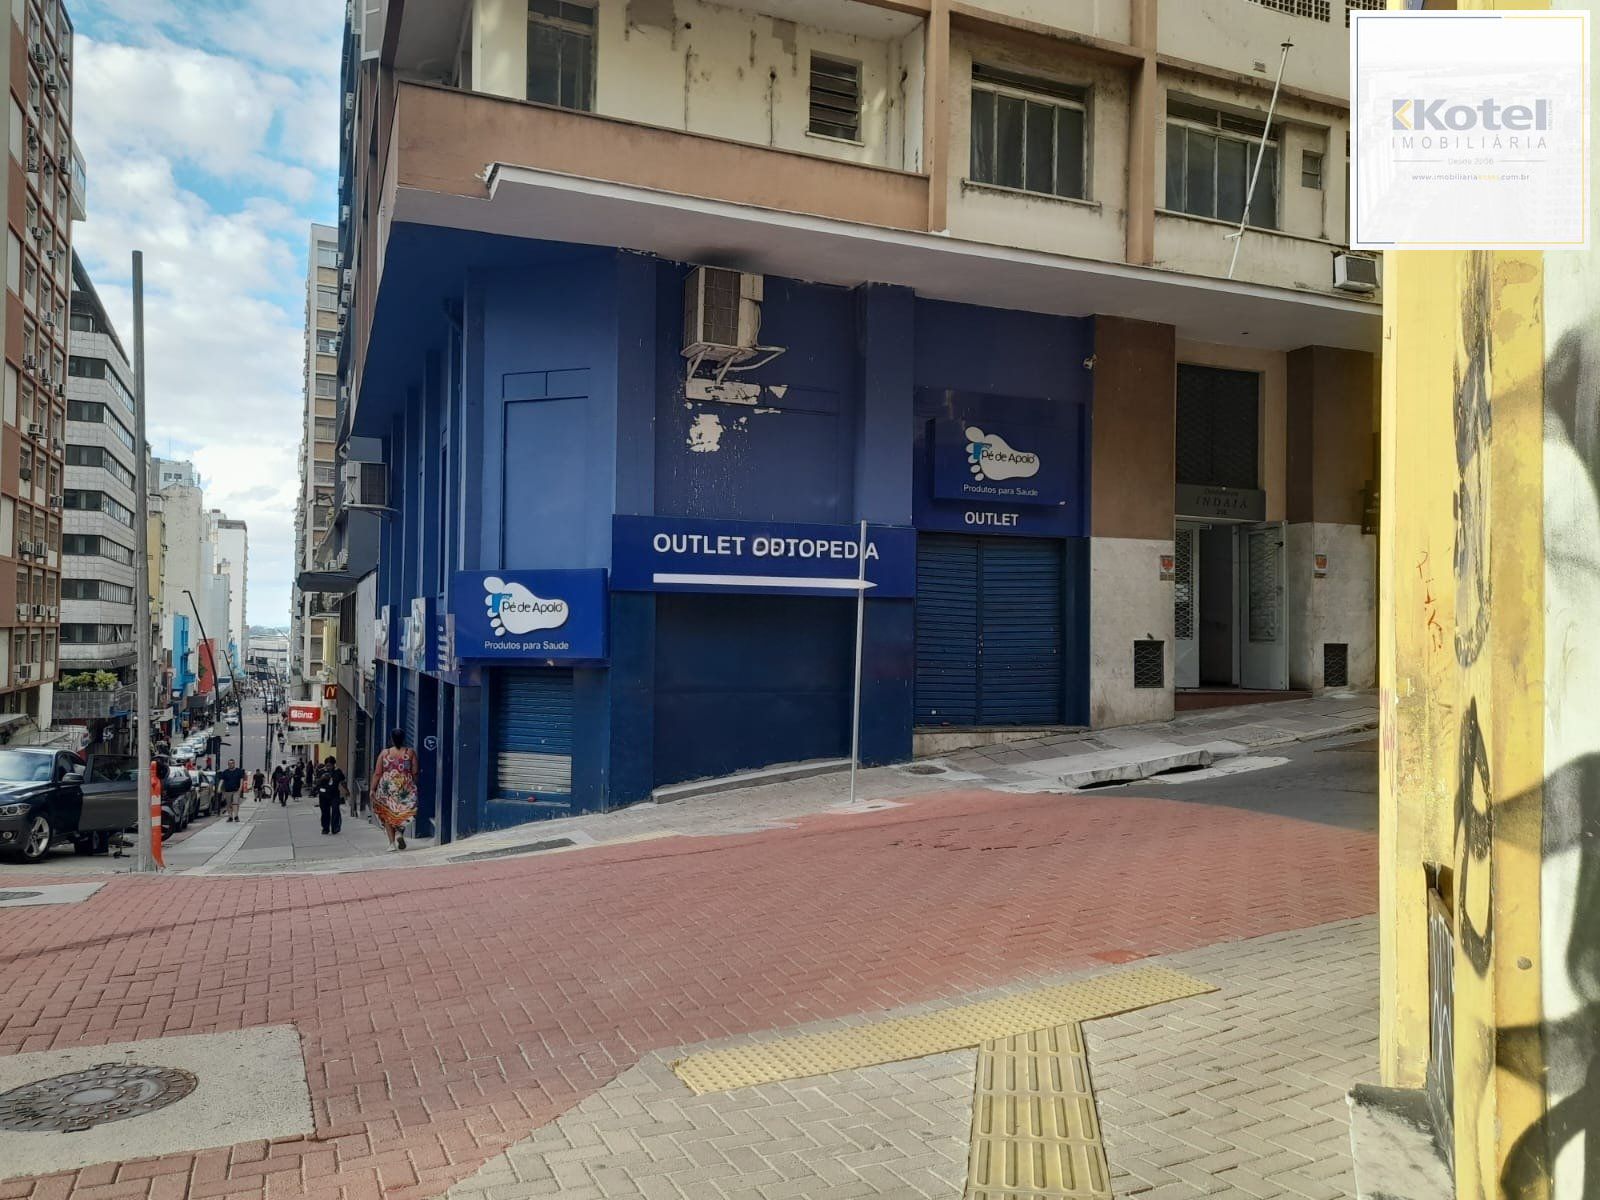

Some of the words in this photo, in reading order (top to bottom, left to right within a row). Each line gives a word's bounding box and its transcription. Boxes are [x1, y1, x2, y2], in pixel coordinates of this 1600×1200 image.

[981, 450, 994, 461] Pé
[995, 452, 1007, 462] de
[1008, 453, 1035, 465] Apoio
[963, 484, 997, 494] Produtos
[998, 487, 1015, 496] para
[964, 511, 1019, 526] OUTLET
[653, 533, 746, 556] OUTLET
[502, 601, 516, 613] Pé
[517, 601, 531, 613] de
[531, 601, 563, 615] Apoio
[484, 640, 521, 650] Produtos
[523, 643, 541, 651] para
